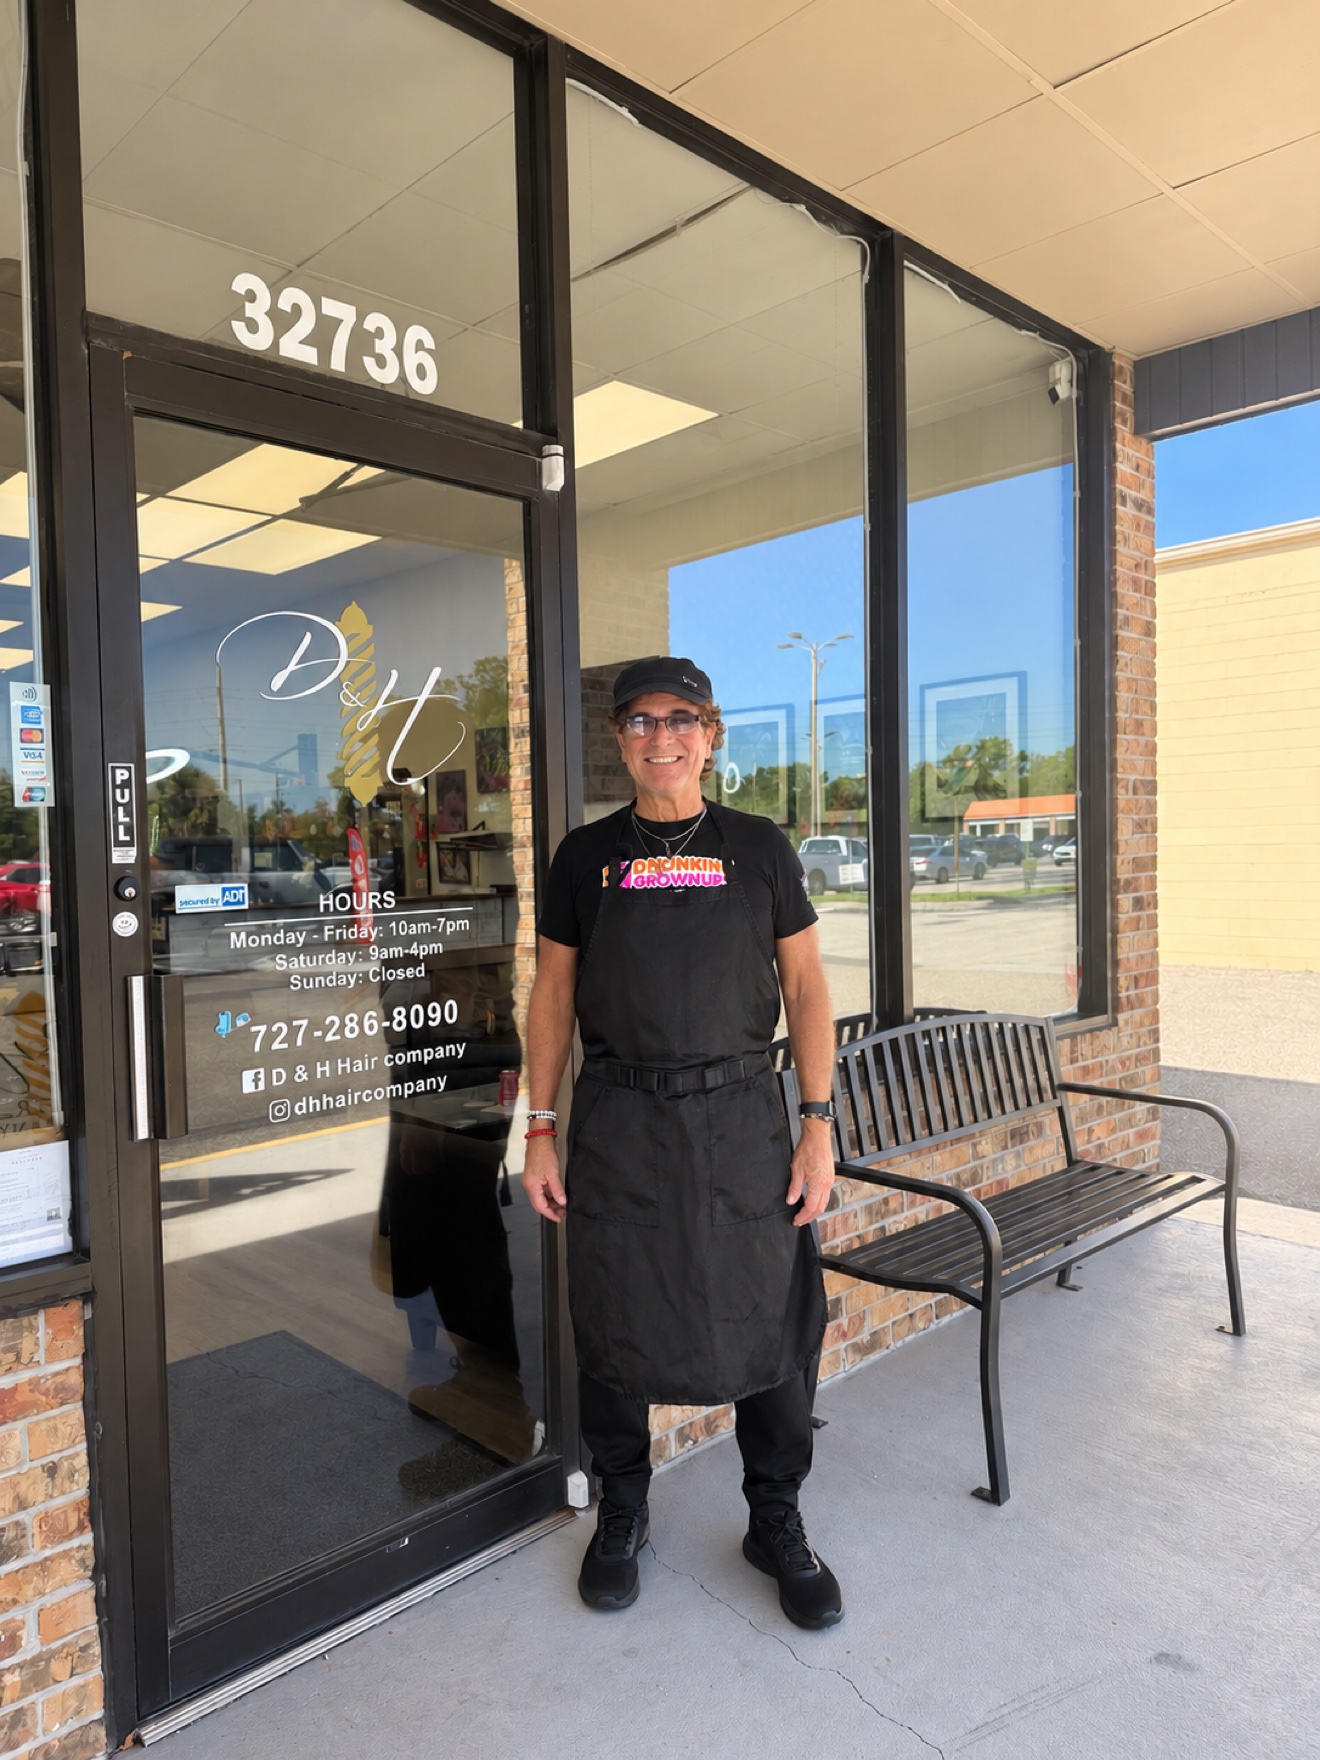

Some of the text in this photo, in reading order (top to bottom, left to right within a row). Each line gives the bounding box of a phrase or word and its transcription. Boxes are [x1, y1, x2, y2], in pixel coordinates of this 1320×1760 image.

[231, 272, 438, 395] 32736
[215, 610, 376, 701] D
[339, 681, 368, 708] &
[115, 768, 131, 841] PULL
[223, 889, 245, 903] ADT
[319, 890, 396, 912] HOURS
[230, 929, 306, 949] Monday
[323, 924, 383, 942] Friday:
[389, 917, 470, 937] 10am-7pm
[275, 941, 443, 971] Saturday: 9am-4pm
[289, 963, 426, 991] Sunday: Closed
[250, 999, 458, 1053] 727-286-8090
[271, 1042, 467, 1086] D & H Hair company
[294, 1075, 448, 1116] dhhaircompany
